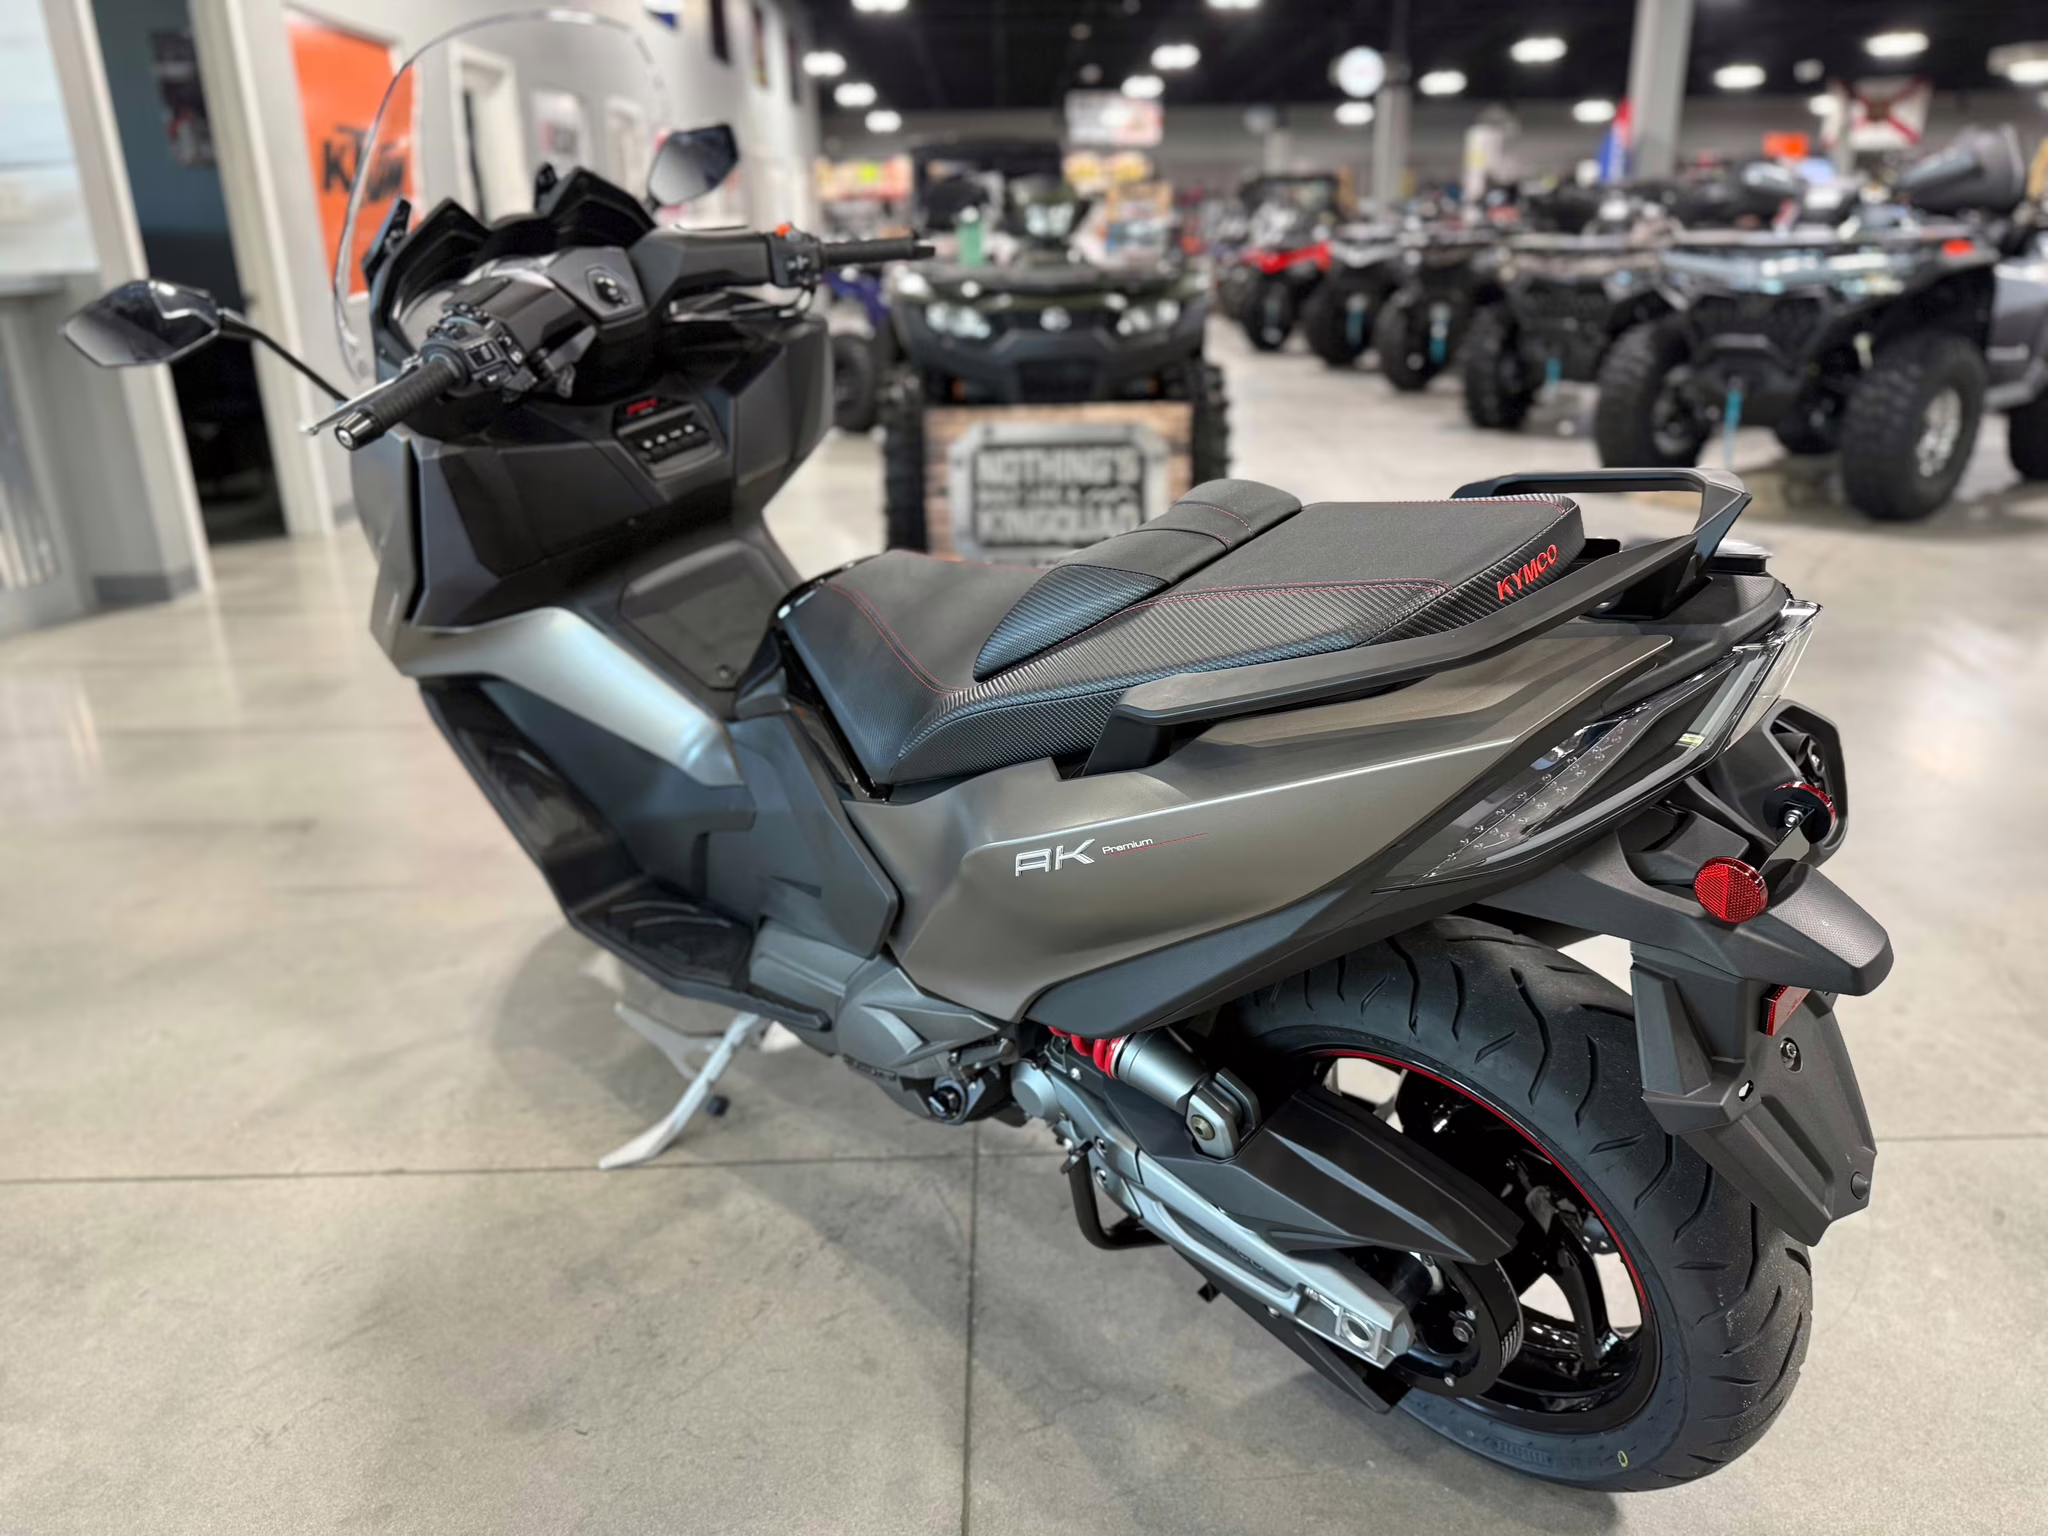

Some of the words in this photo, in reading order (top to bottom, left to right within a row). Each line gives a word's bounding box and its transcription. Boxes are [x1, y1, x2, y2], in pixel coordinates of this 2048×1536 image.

[1497, 544, 1558, 601] KYMCO
[1015, 838, 1096, 877] AK
[1102, 838, 1154, 855] Premium
